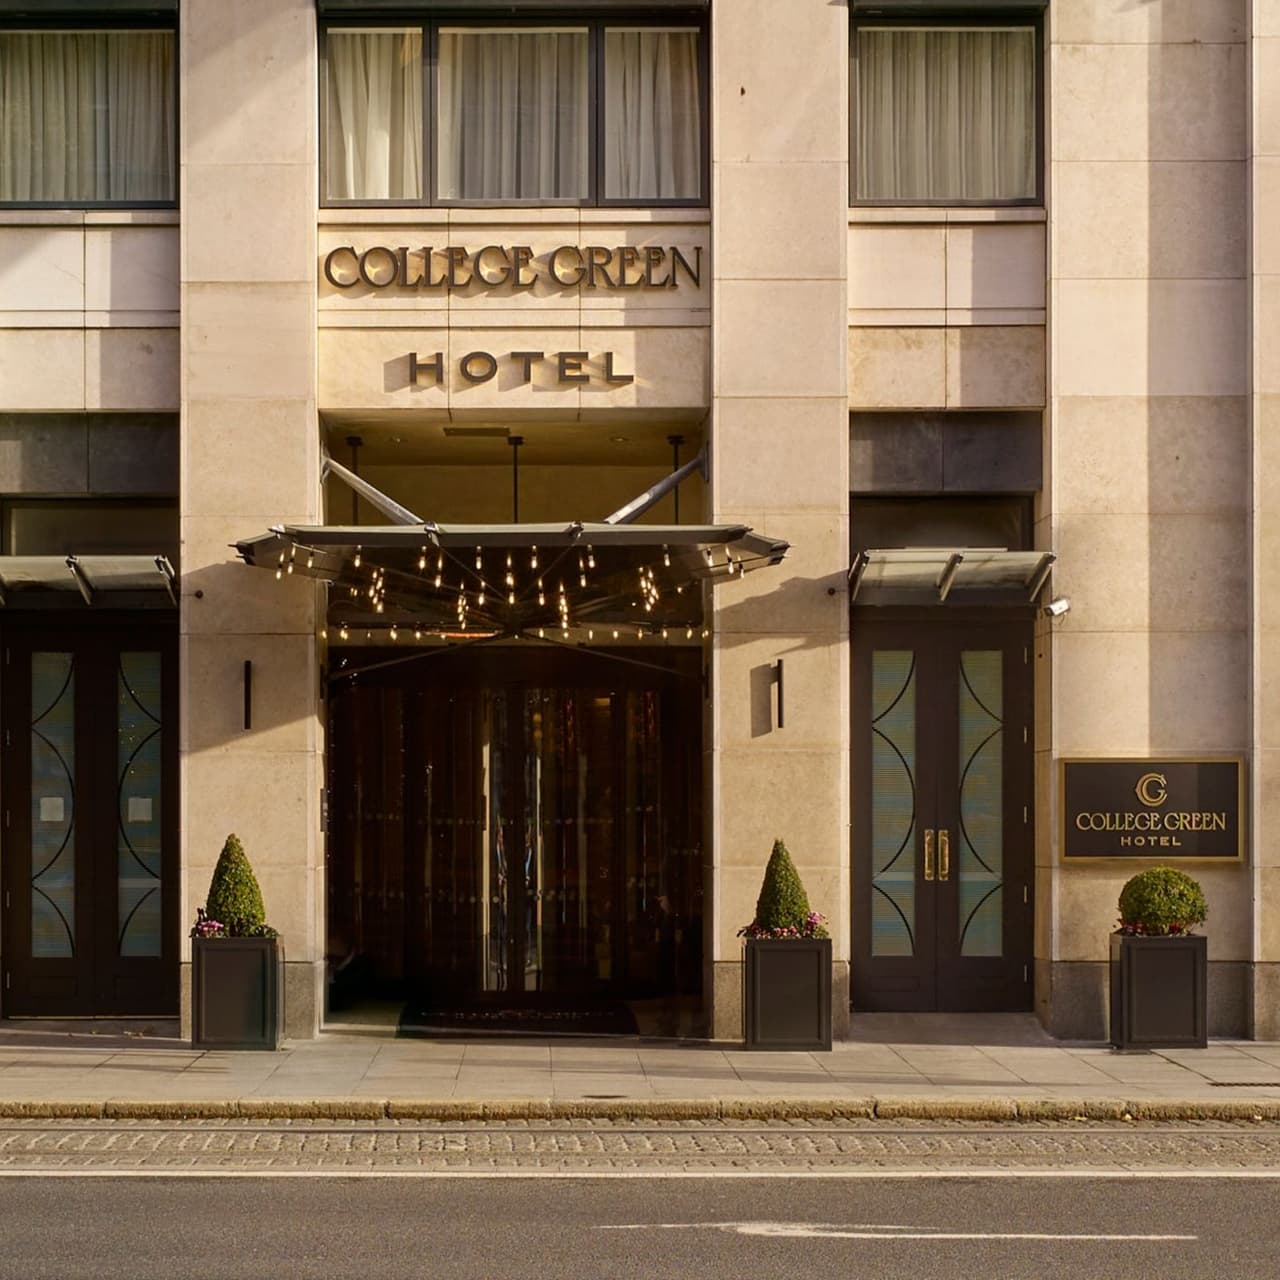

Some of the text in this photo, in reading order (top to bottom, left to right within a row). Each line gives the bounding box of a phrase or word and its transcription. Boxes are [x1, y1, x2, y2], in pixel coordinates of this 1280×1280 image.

[324, 245, 703, 289] COLLEGE GREEN
[408, 351, 634, 383] HOTEL
[1076, 812, 1226, 831] COLLEGE GREEN
[1120, 836, 1182, 846] HOTEL
